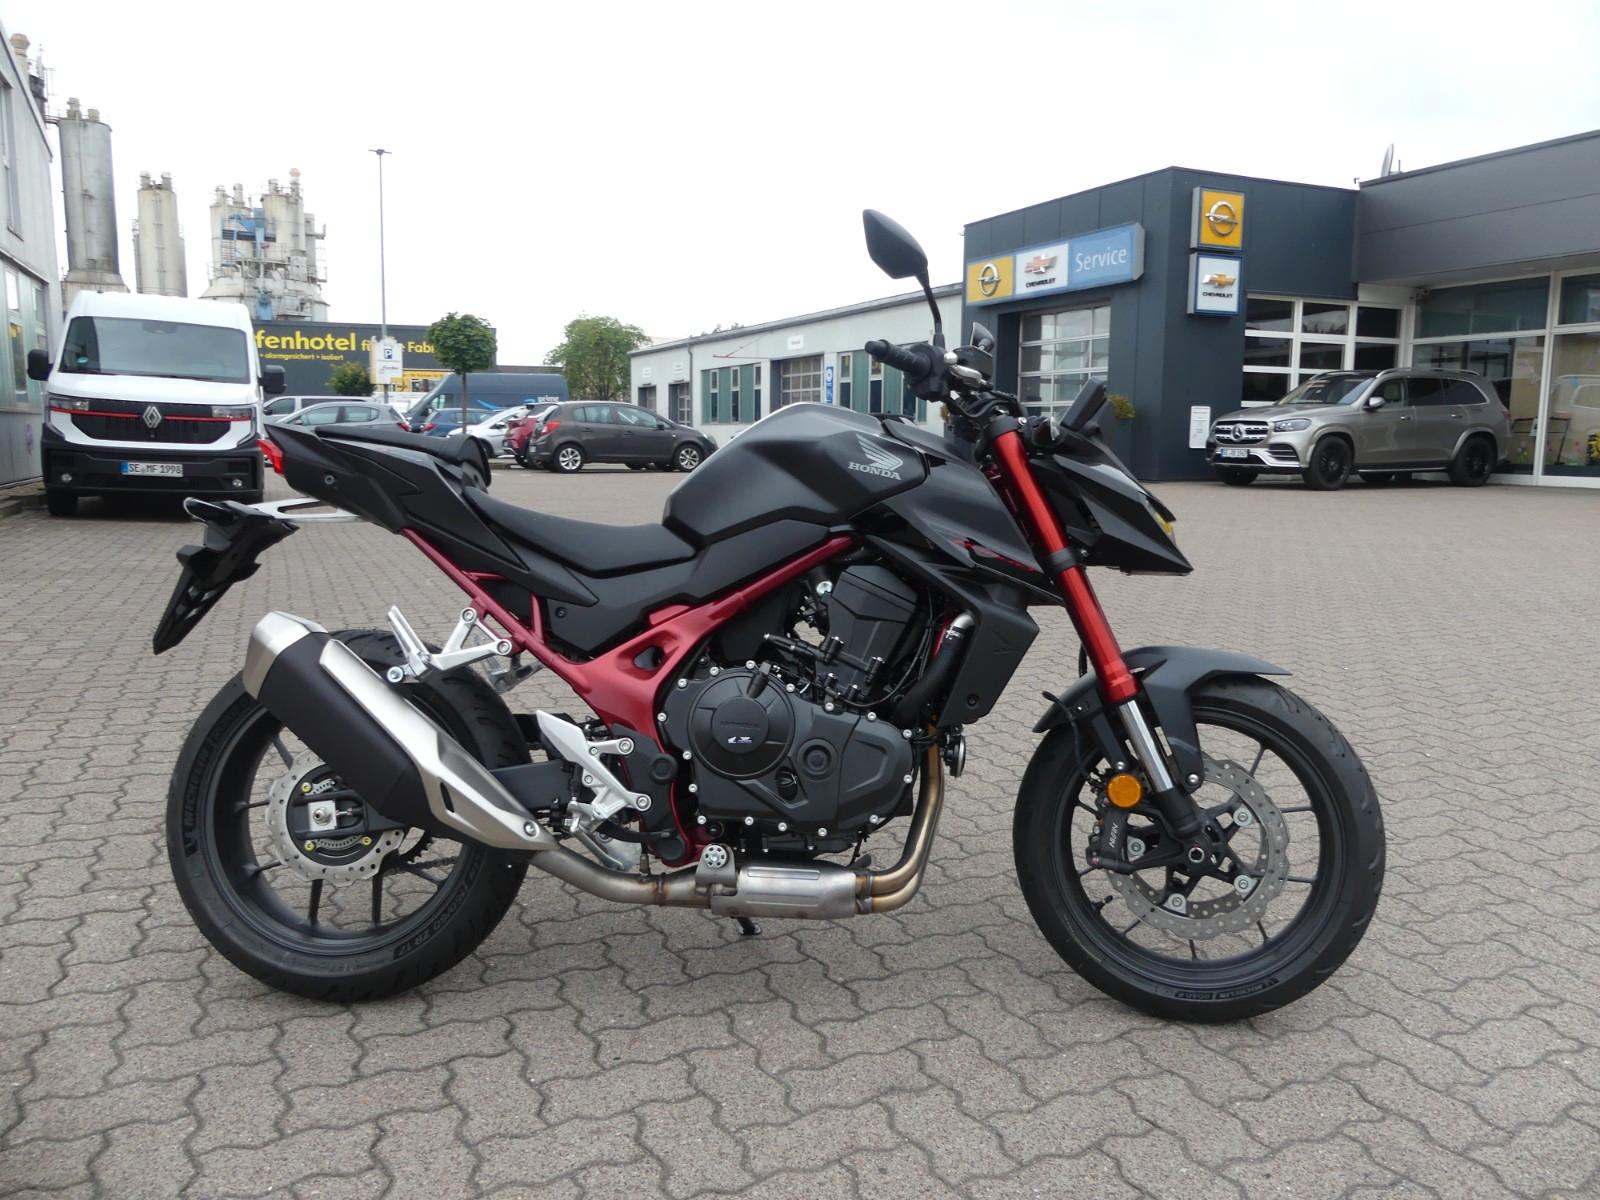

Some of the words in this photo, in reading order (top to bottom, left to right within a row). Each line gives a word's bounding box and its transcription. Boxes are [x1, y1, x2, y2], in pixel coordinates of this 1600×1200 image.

[1075, 246, 1127, 272] Service
[1025, 277, 1056, 288] CHEVROLET
[255, 329, 356, 351] fenhotel
[128, 463, 140, 473] SE
[146, 464, 158, 473] MF
[160, 464, 182, 474] 1998
[848, 462, 902, 480] HONDA
